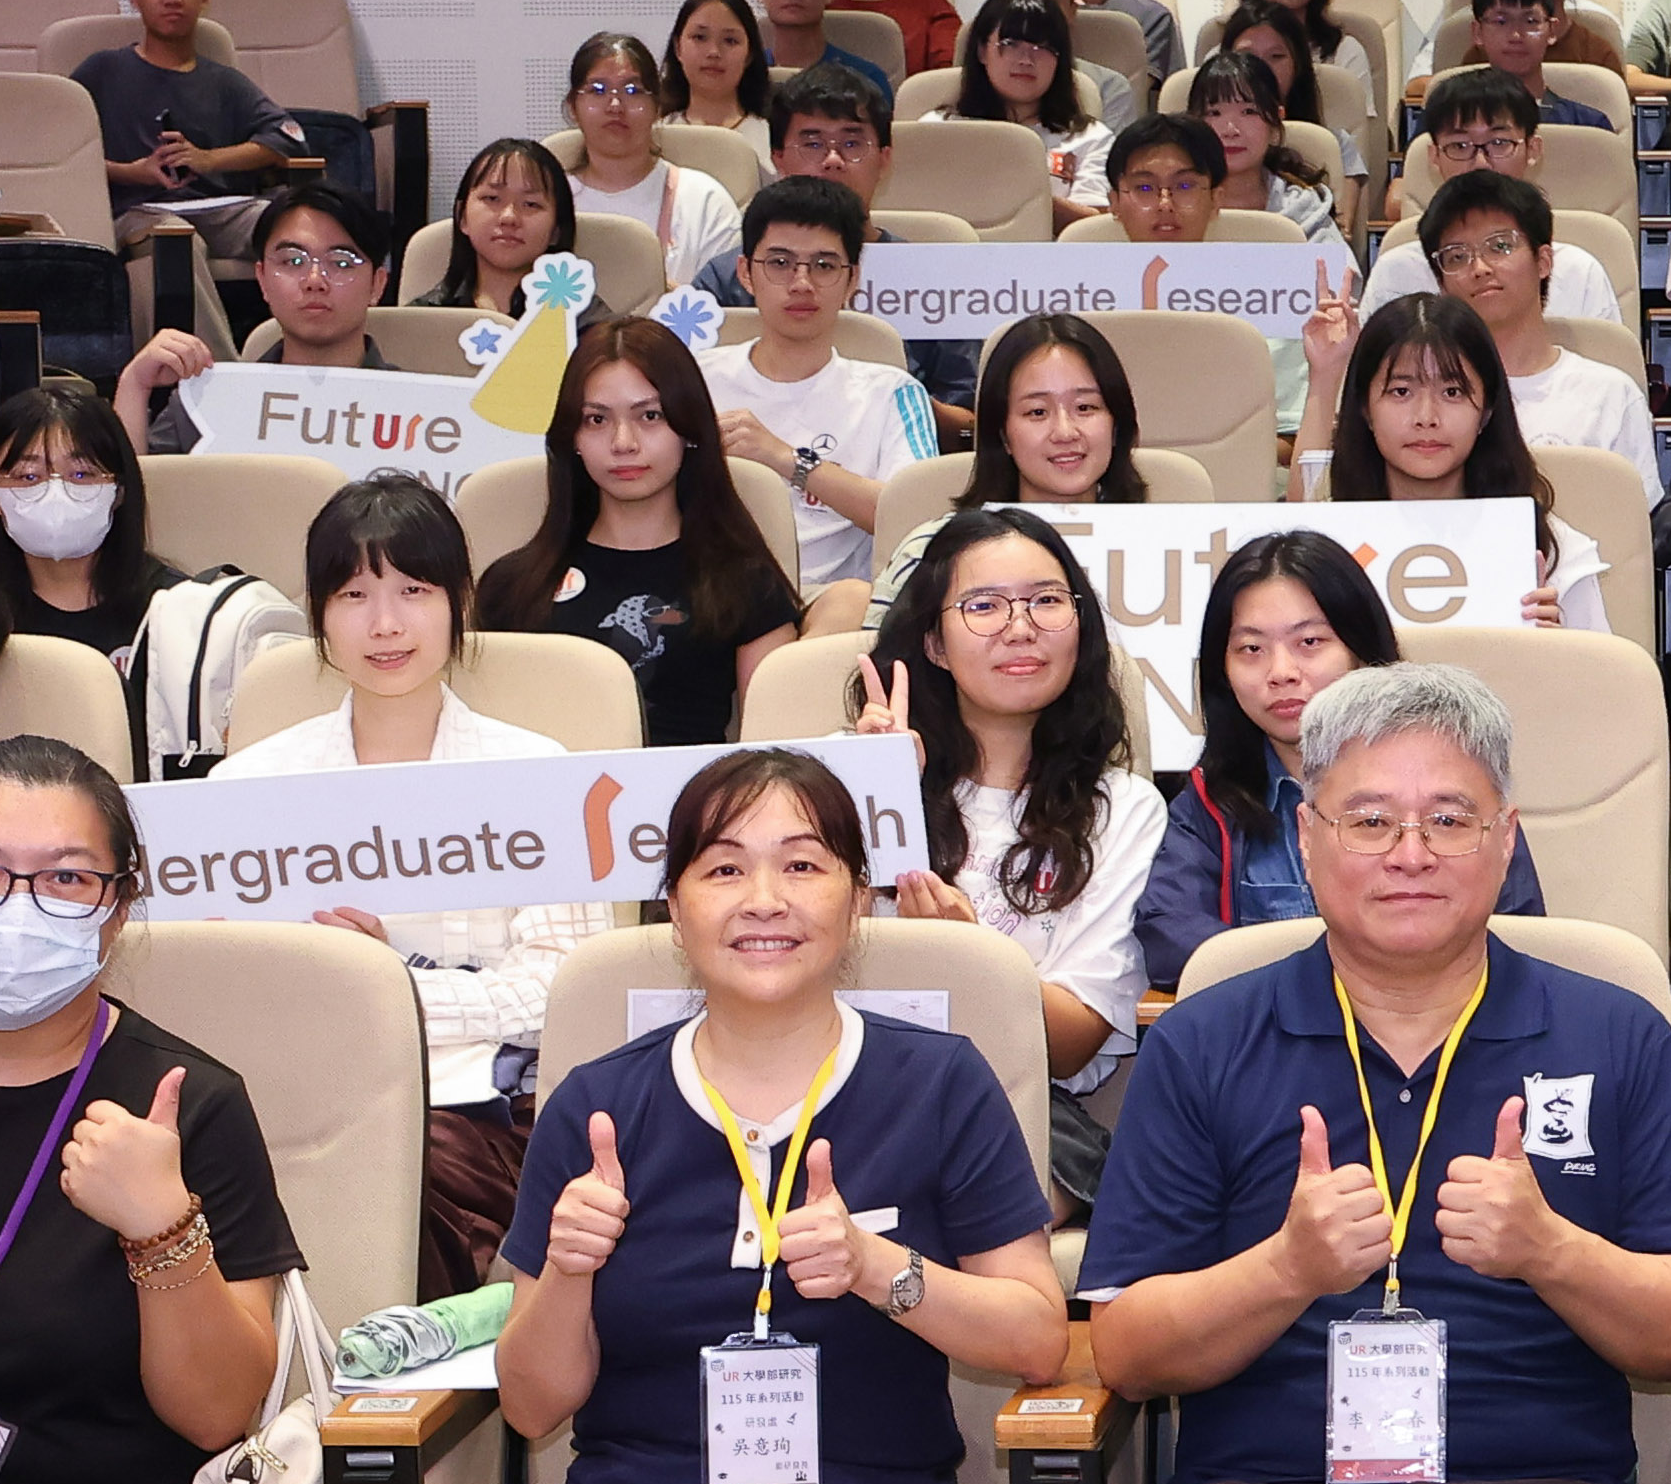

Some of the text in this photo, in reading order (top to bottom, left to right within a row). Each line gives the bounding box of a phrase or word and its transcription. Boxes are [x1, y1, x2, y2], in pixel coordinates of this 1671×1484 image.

[848, 279, 1116, 324] dergraduate
[256, 391, 462, 454] Future
[722, 1371, 740, 1382] UR
[721, 1394, 742, 1404] 115
